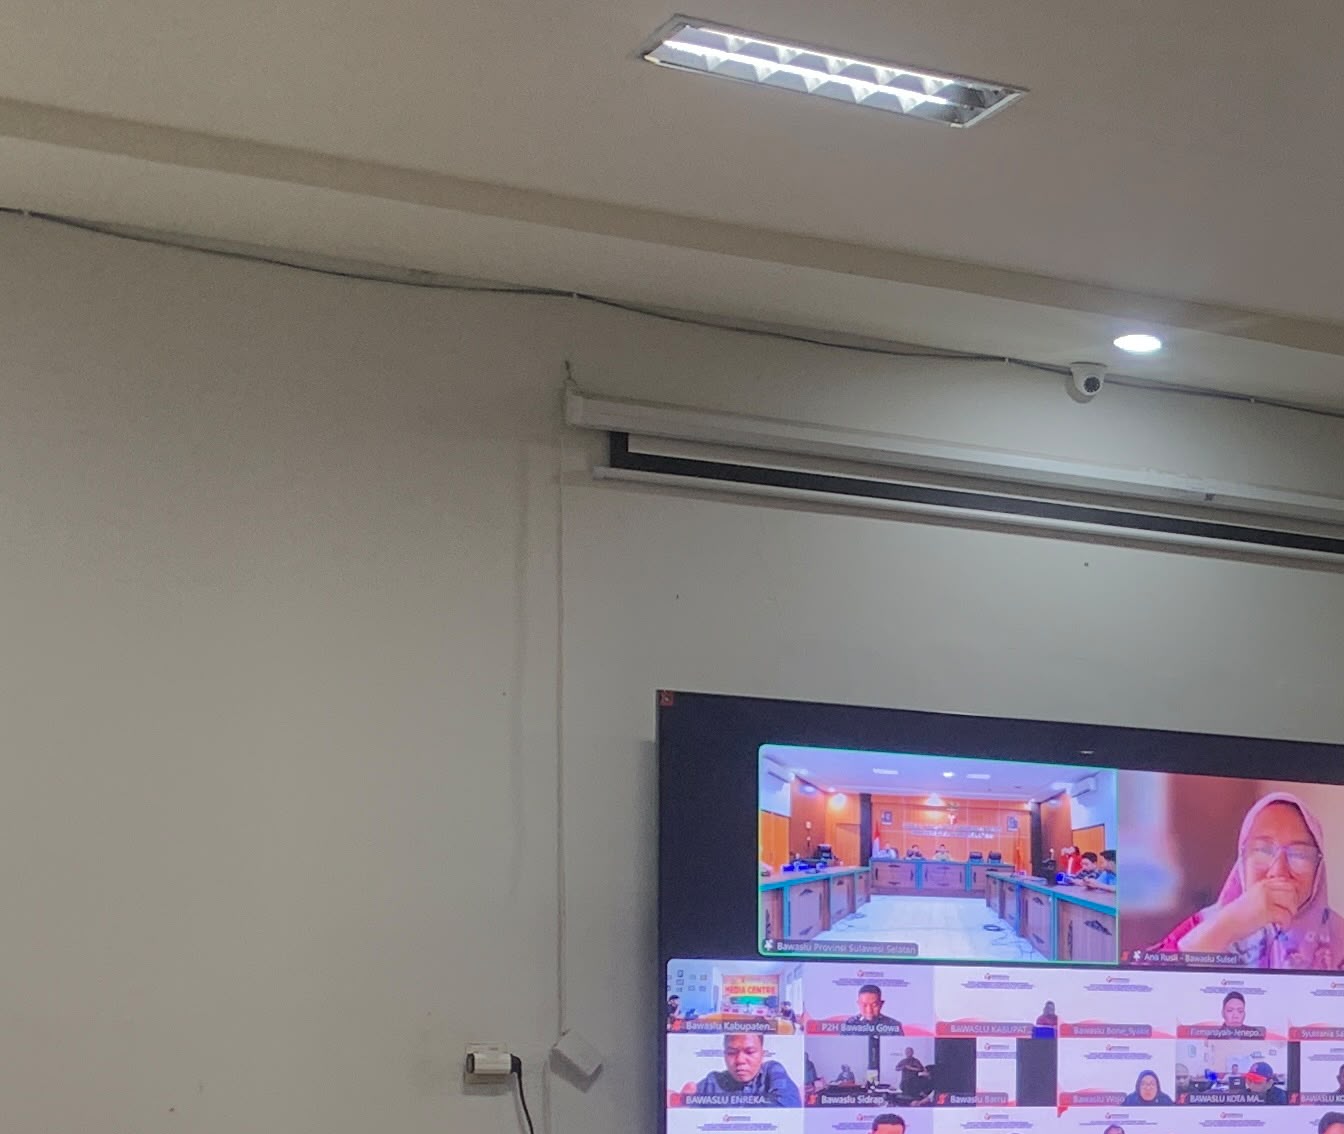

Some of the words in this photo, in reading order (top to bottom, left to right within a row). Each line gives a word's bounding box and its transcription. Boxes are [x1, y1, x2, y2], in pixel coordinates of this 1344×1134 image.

[777, 942, 812, 951] Bawaslu
[686, 1021, 722, 1030] Bawaslu
[686, 1096, 728, 1104] BAWASLU
[822, 1095, 856, 1104] Bawaslu
[1190, 1094, 1225, 1103] BAWASLU
